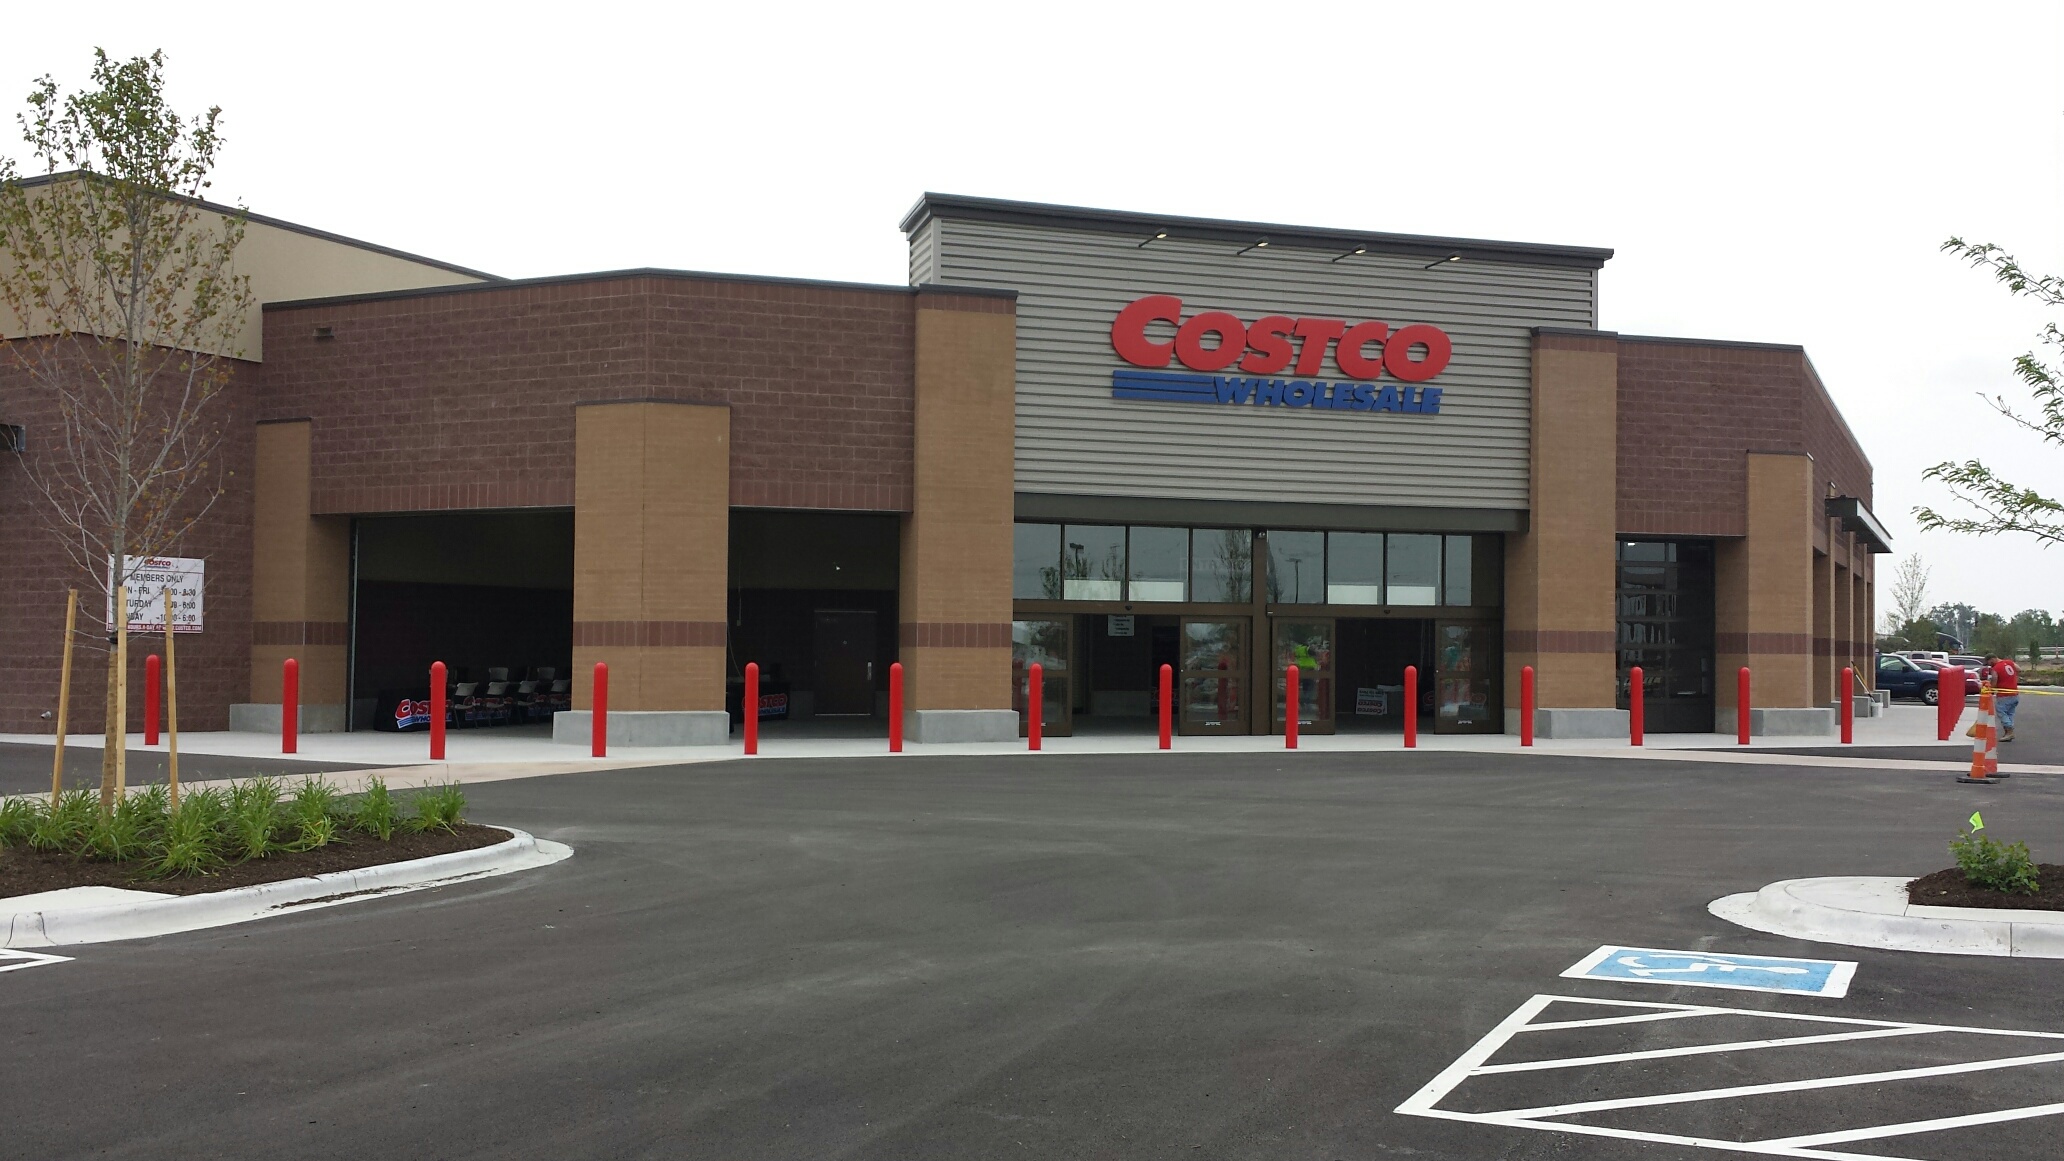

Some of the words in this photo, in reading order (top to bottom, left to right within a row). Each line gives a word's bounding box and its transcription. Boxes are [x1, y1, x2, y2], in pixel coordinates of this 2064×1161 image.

[1111, 294, 1452, 382] COSTCO
[1214, 376, 1443, 415] WHOLESALE
[144, 558, 172, 567] OSTCO
[130, 573, 165, 583] MEMBERS
[166, 574, 184, 583] ONLY
[138, 586, 150, 595] FRI
